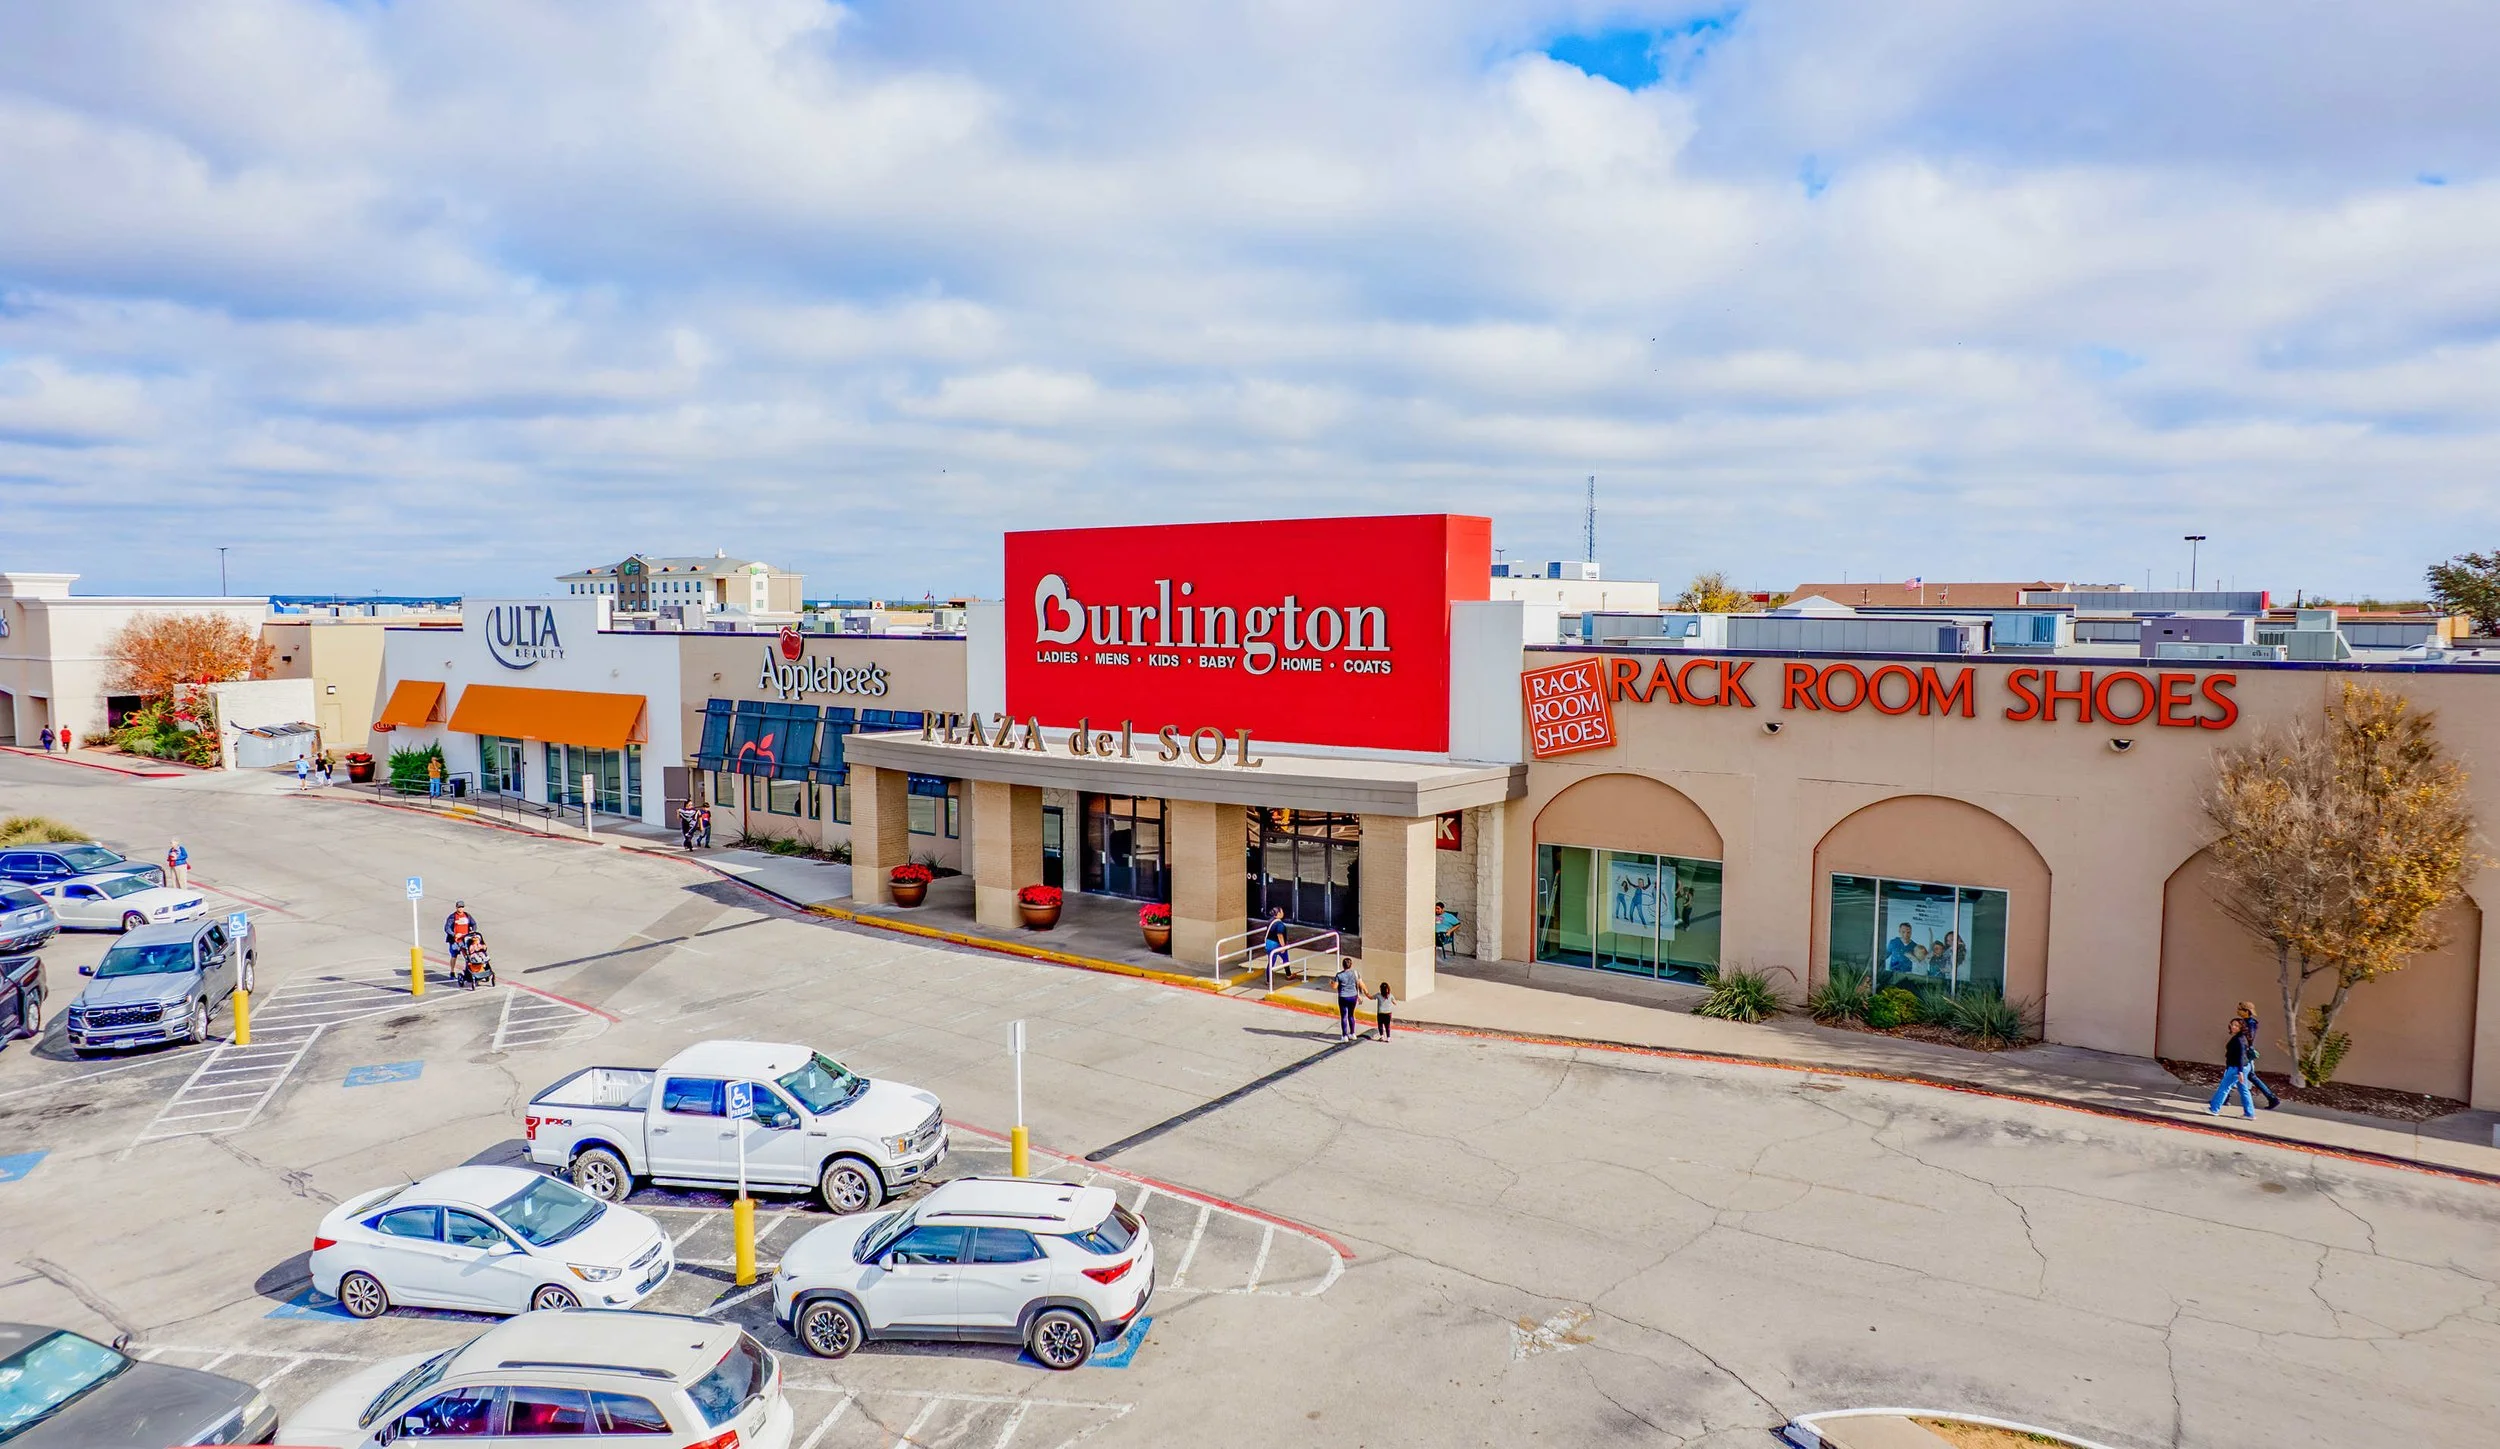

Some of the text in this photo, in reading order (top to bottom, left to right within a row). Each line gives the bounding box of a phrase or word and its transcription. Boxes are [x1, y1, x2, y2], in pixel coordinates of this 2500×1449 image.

[495, 605, 561, 647] ULTA
[1035, 573, 1391, 675] Burlington
[515, 648, 565, 659] BEAUTY
[1036, 651, 1391, 675] LADIES MENS KIDS BABY HOME COATS
[758, 645, 888, 700] Applebee's
[1532, 667, 1592, 699] RACK
[1532, 691, 1601, 724] ROOM
[1610, 658, 2239, 730] RACK ROOM SHOES
[921, 709, 1264, 768] PLAZA del SOL
[1536, 717, 1606, 749] SHOES
[545, 1117, 572, 1126] FX4
